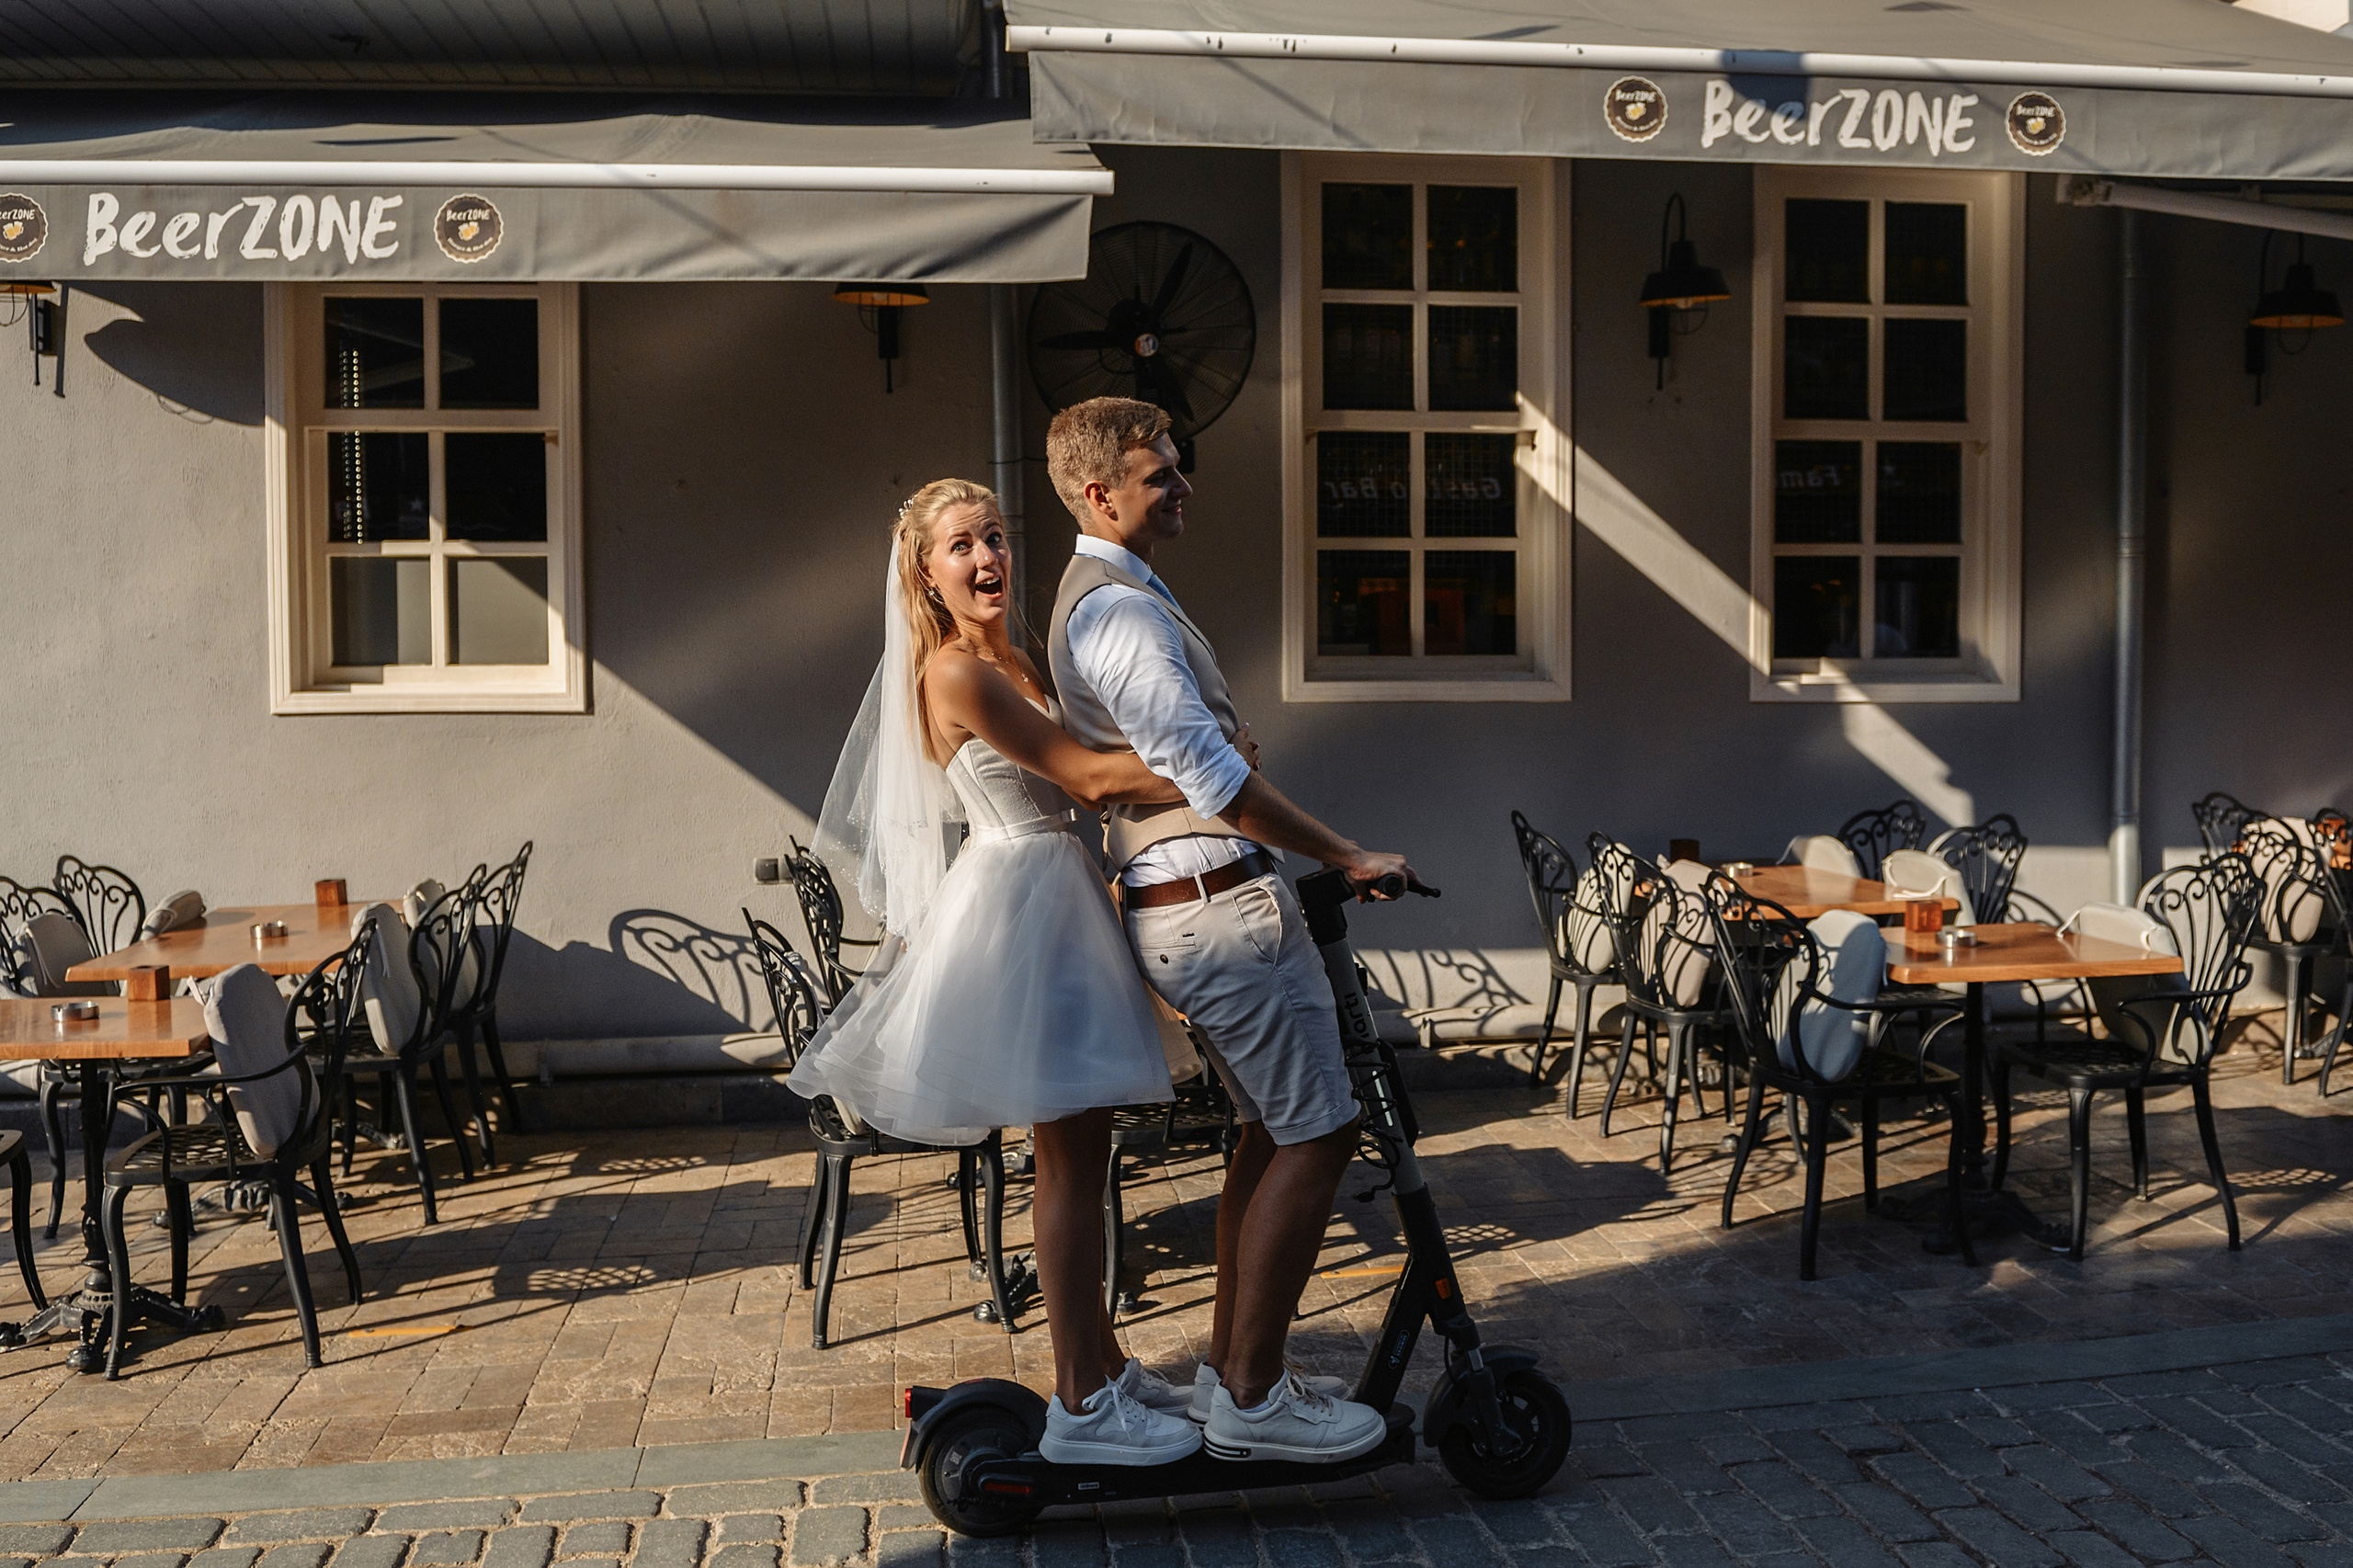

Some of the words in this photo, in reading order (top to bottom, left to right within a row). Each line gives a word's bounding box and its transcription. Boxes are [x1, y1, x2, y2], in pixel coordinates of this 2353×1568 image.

[1700, 79, 1979, 157] BeerZONE
[83, 192, 404, 267] BeerZONE
[447, 209, 491, 222] BeerZONE
